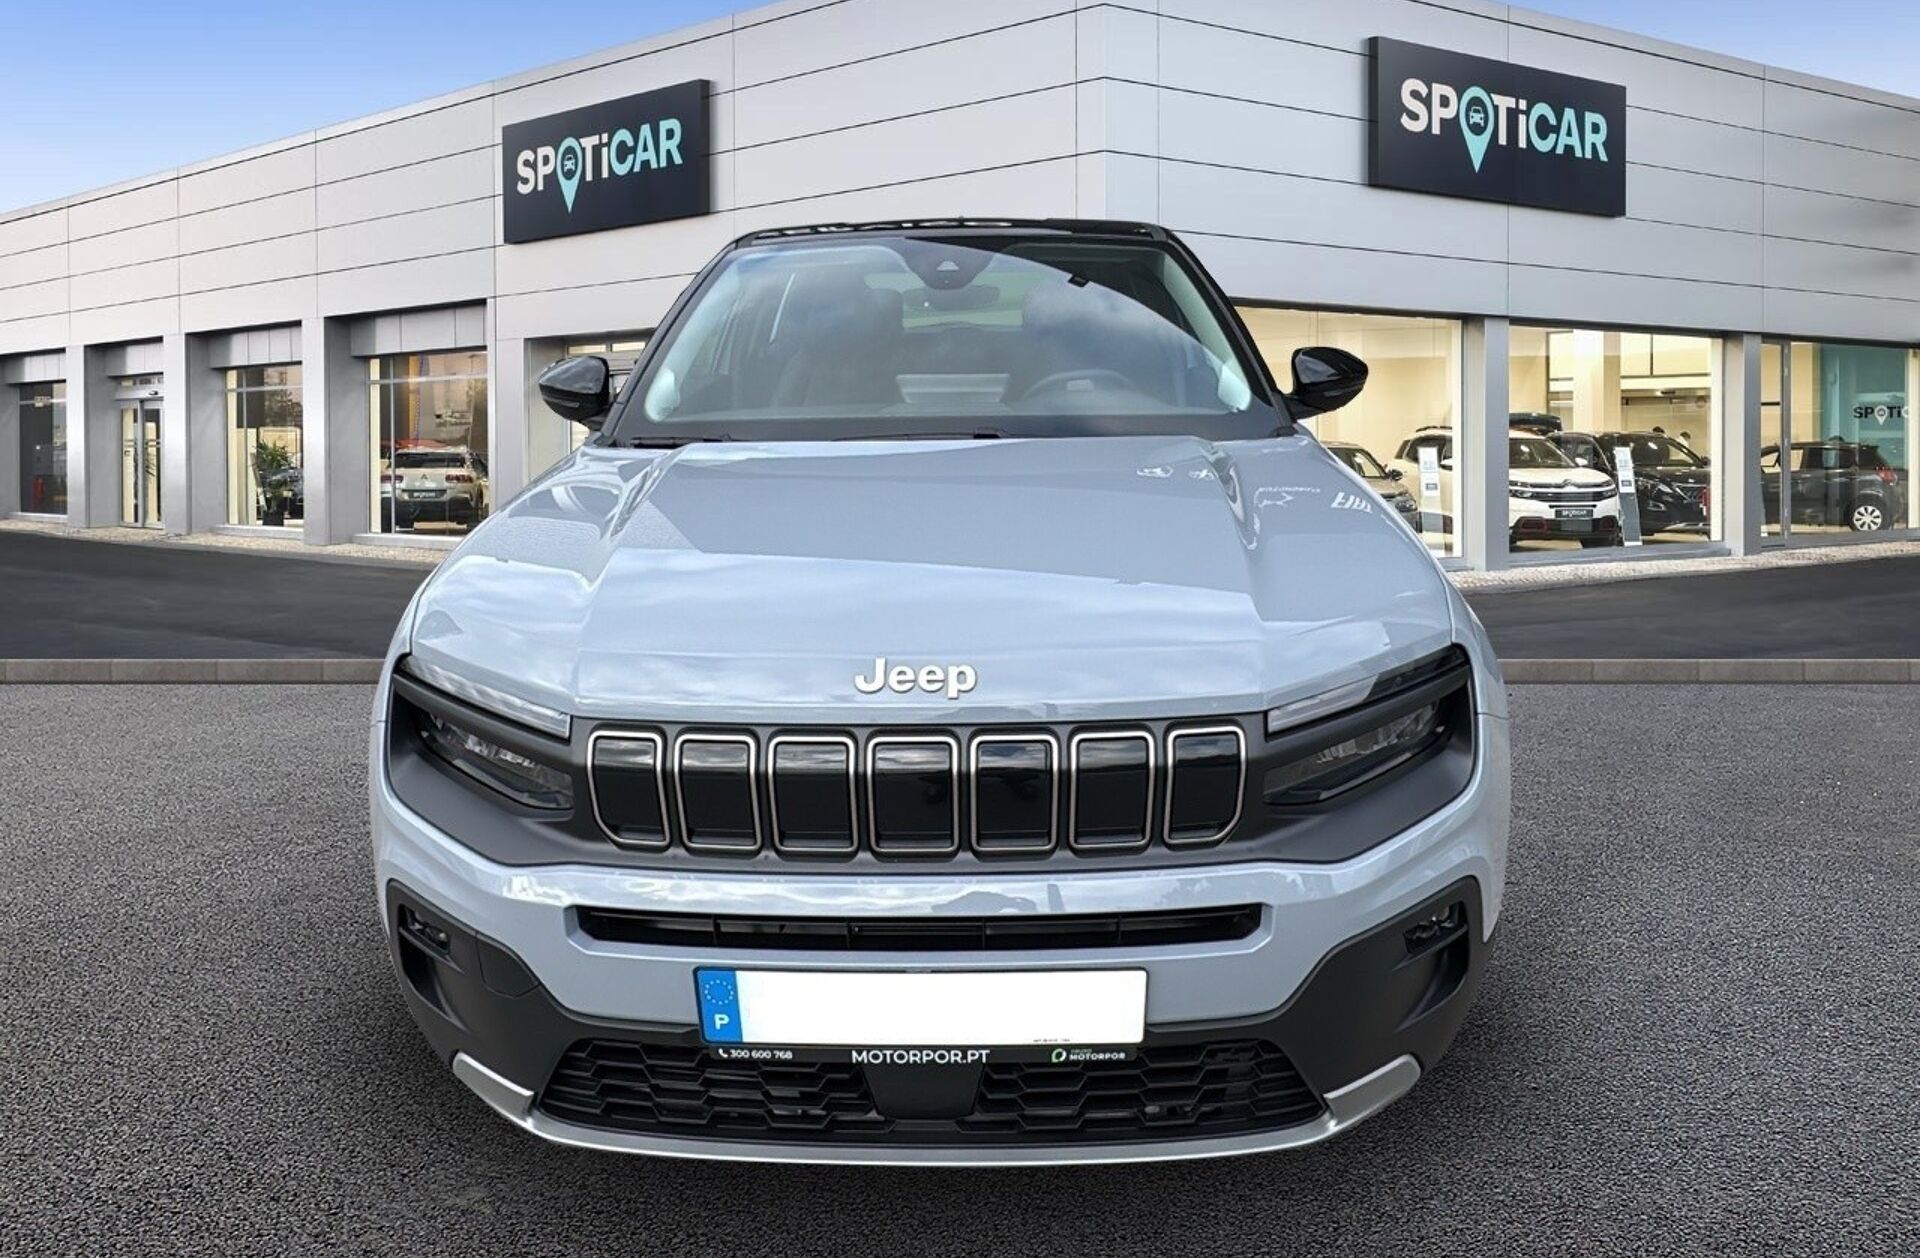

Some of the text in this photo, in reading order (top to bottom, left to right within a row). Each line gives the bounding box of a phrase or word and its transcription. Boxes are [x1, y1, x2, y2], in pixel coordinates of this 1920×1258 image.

[854, 656, 977, 700] Jeep
[714, 1013, 730, 1030] P
[729, 1049, 793, 1059] 300 600 768
[851, 1049, 990, 1065] MOTORPOR.PT
[1069, 1052, 1126, 1061] MOTORPOR
